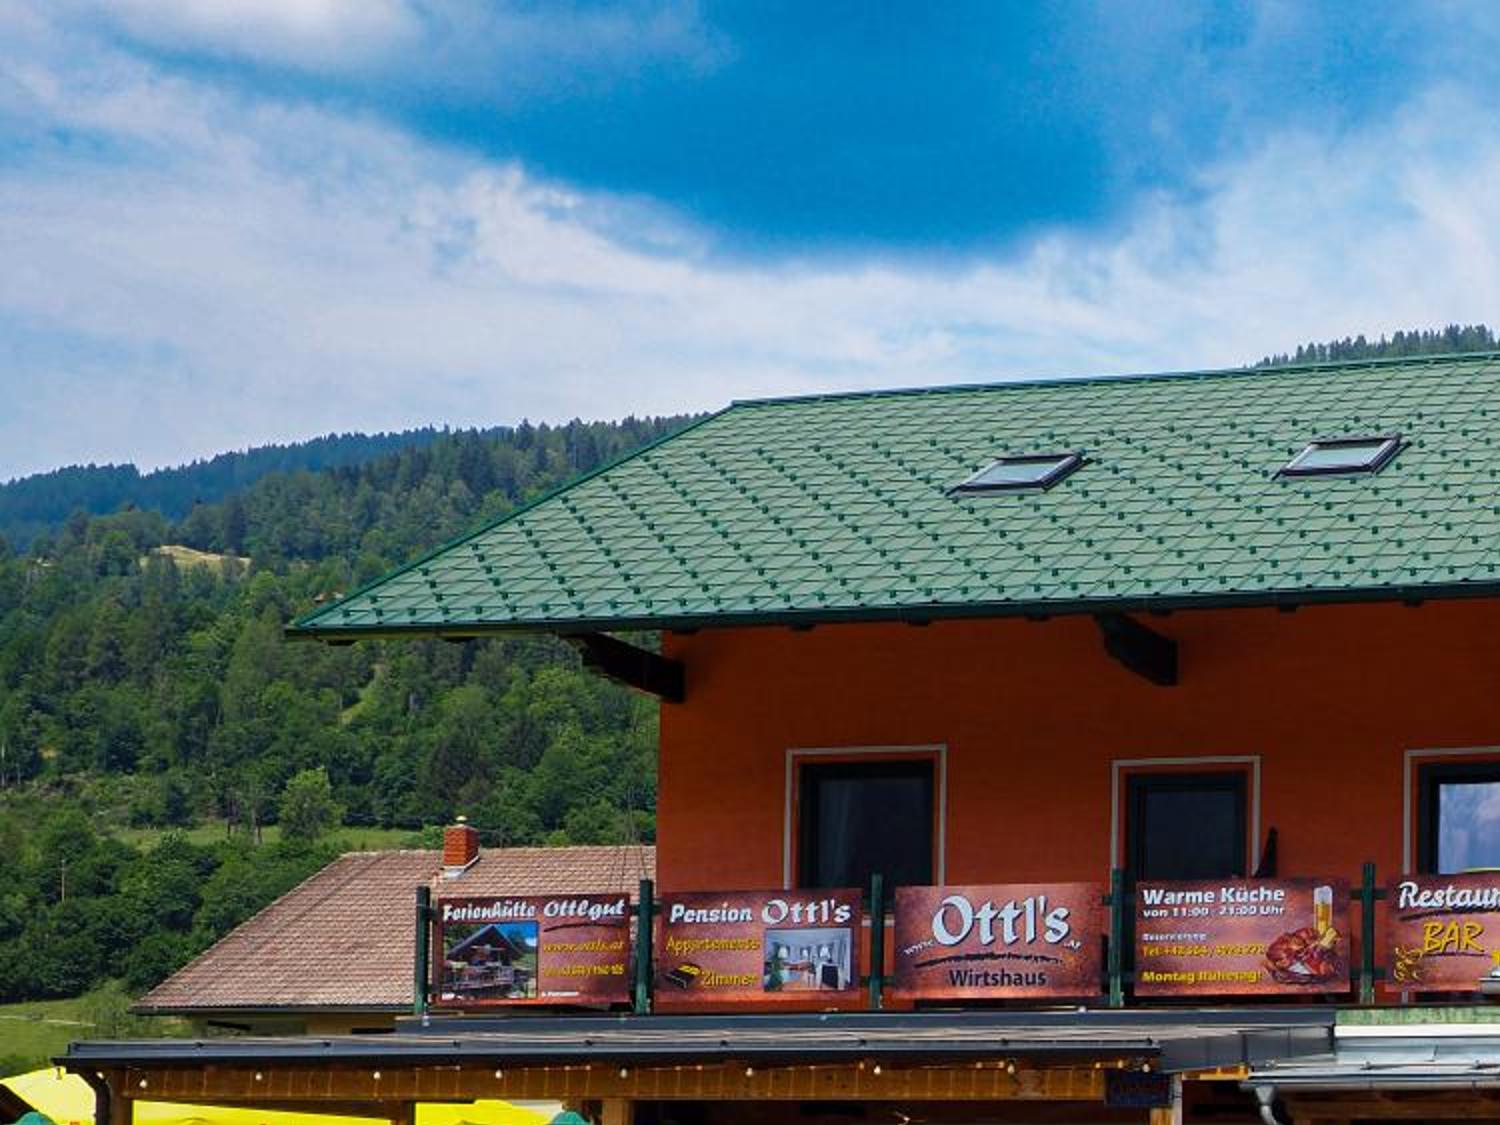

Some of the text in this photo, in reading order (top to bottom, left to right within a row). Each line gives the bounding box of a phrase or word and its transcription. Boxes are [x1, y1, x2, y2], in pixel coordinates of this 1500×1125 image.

[1143, 885, 1285, 905] Warme Küche
[443, 902, 535, 921] Ferienhütte
[670, 899, 851, 924] Pension Ottl's
[932, 895, 1070, 946] Ottl's
[1143, 909, 1168, 917] von
[1259, 904, 1285, 915] Uhr
[1423, 920, 1484, 953] BAR
[948, 970, 1047, 987] Wirtshaus
